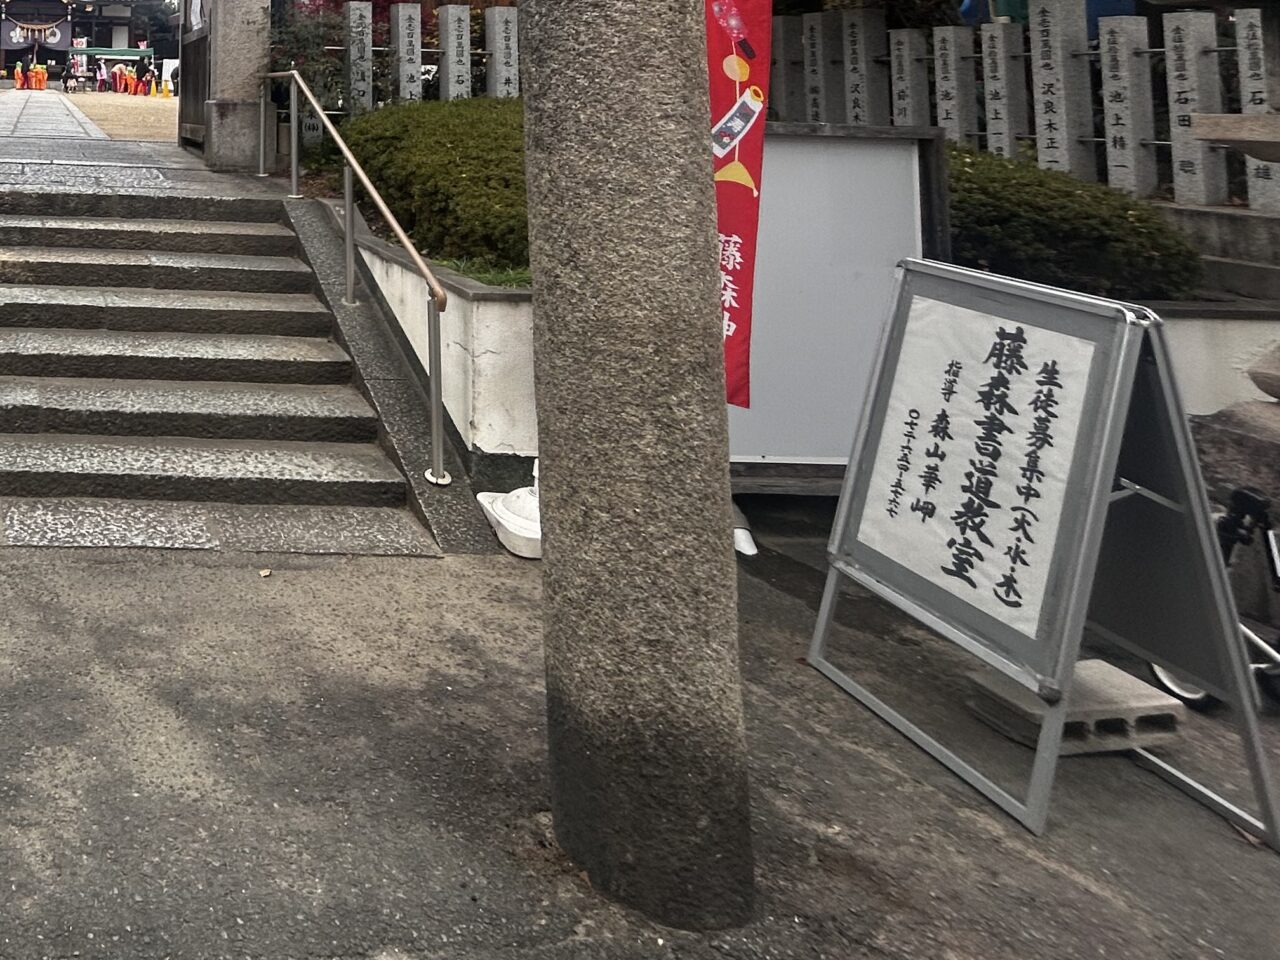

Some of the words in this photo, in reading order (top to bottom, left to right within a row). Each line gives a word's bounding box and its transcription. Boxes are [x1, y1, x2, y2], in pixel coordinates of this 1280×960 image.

[851, 83, 862, 124] 沢良木
[940, 89, 953, 121] 池上
[1041, 82, 1060, 164] 沢良木正一
[941, 360, 963, 403] 指導
[910, 407, 955, 524] 森山華岬
[940, 326, 1029, 589] 藤森書道教室
